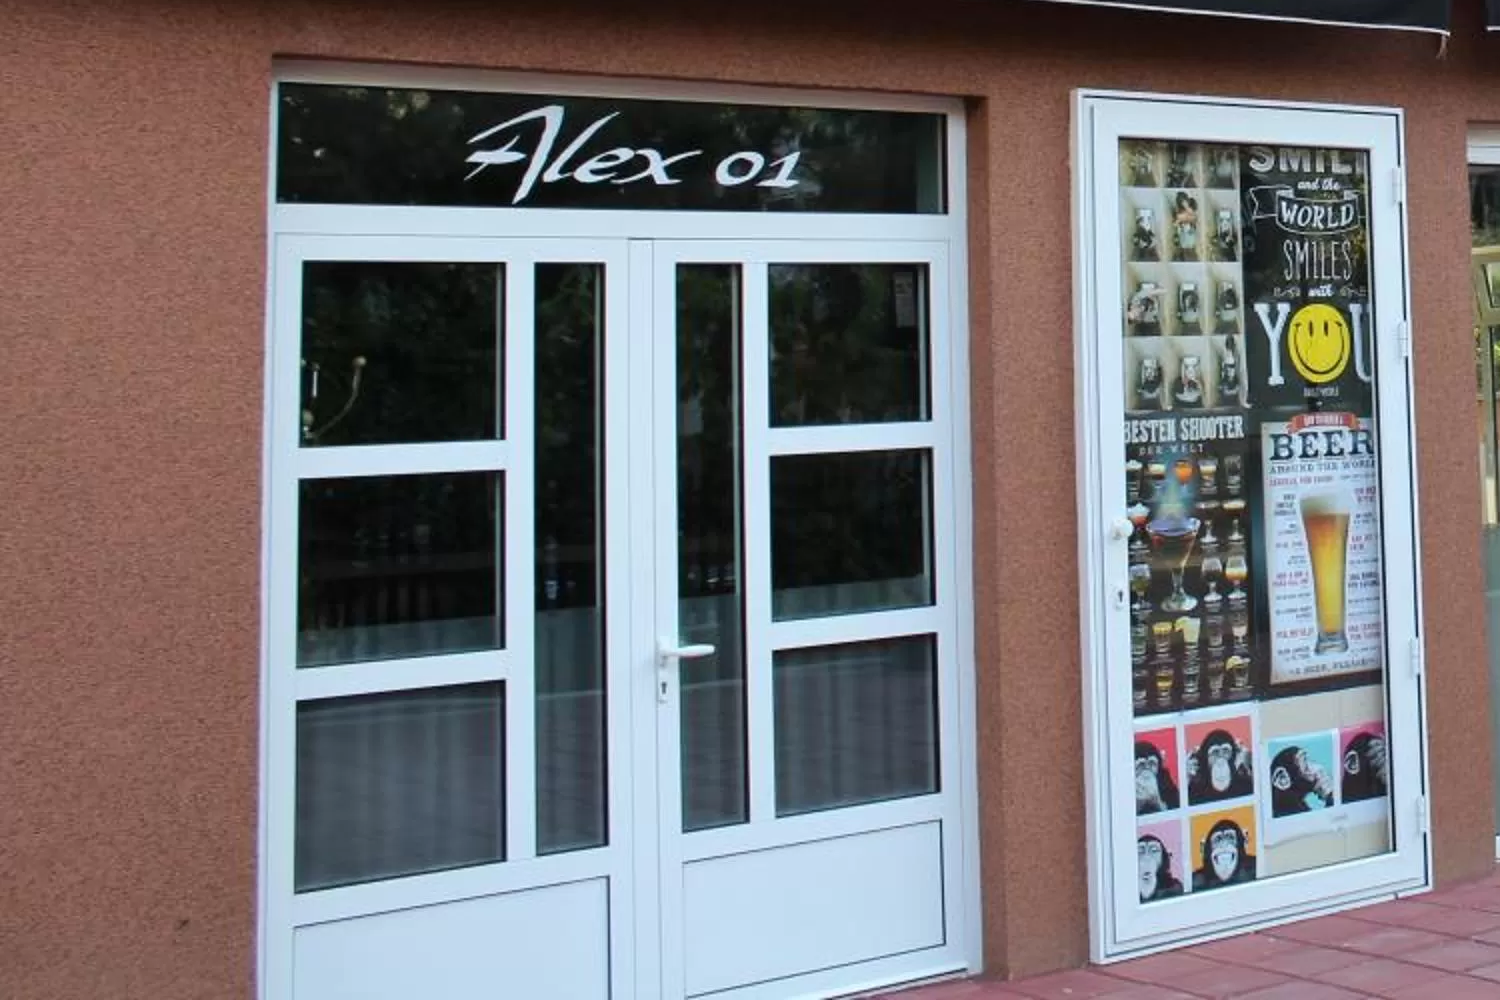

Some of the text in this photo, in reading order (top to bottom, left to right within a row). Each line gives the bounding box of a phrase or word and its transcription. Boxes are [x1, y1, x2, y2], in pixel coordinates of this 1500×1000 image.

[464, 105, 802, 205] Alex 01
[1281, 200, 1355, 229] WORLD
[1283, 239, 1351, 281] SMILES
[1180, 415, 1245, 442] SHOOTER
[1269, 429, 1375, 461] BEER
